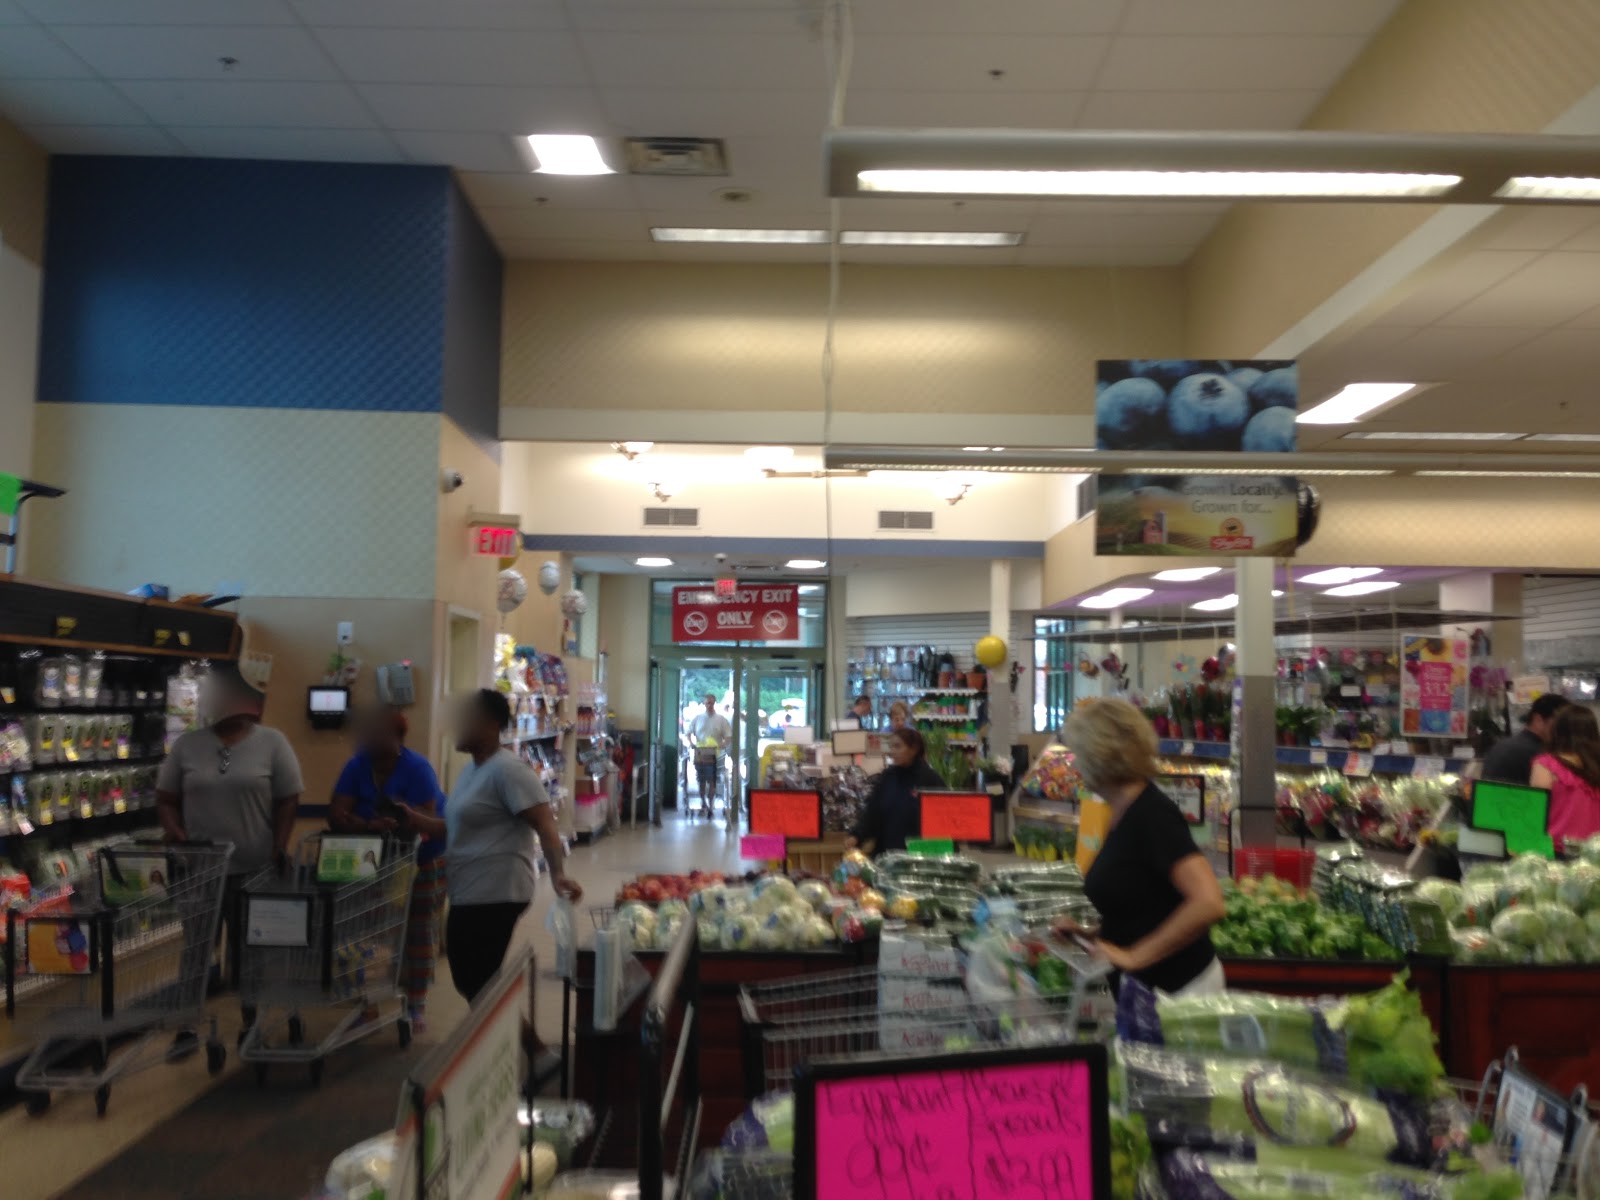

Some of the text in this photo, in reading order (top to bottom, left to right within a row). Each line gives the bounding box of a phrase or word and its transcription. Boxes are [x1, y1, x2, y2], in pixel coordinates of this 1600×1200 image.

[1192, 500, 1238, 513] Grown
[479, 528, 514, 555] EXIT
[678, 589, 793, 605] EMEGENCY EXIT
[717, 611, 753, 625] ONLY
